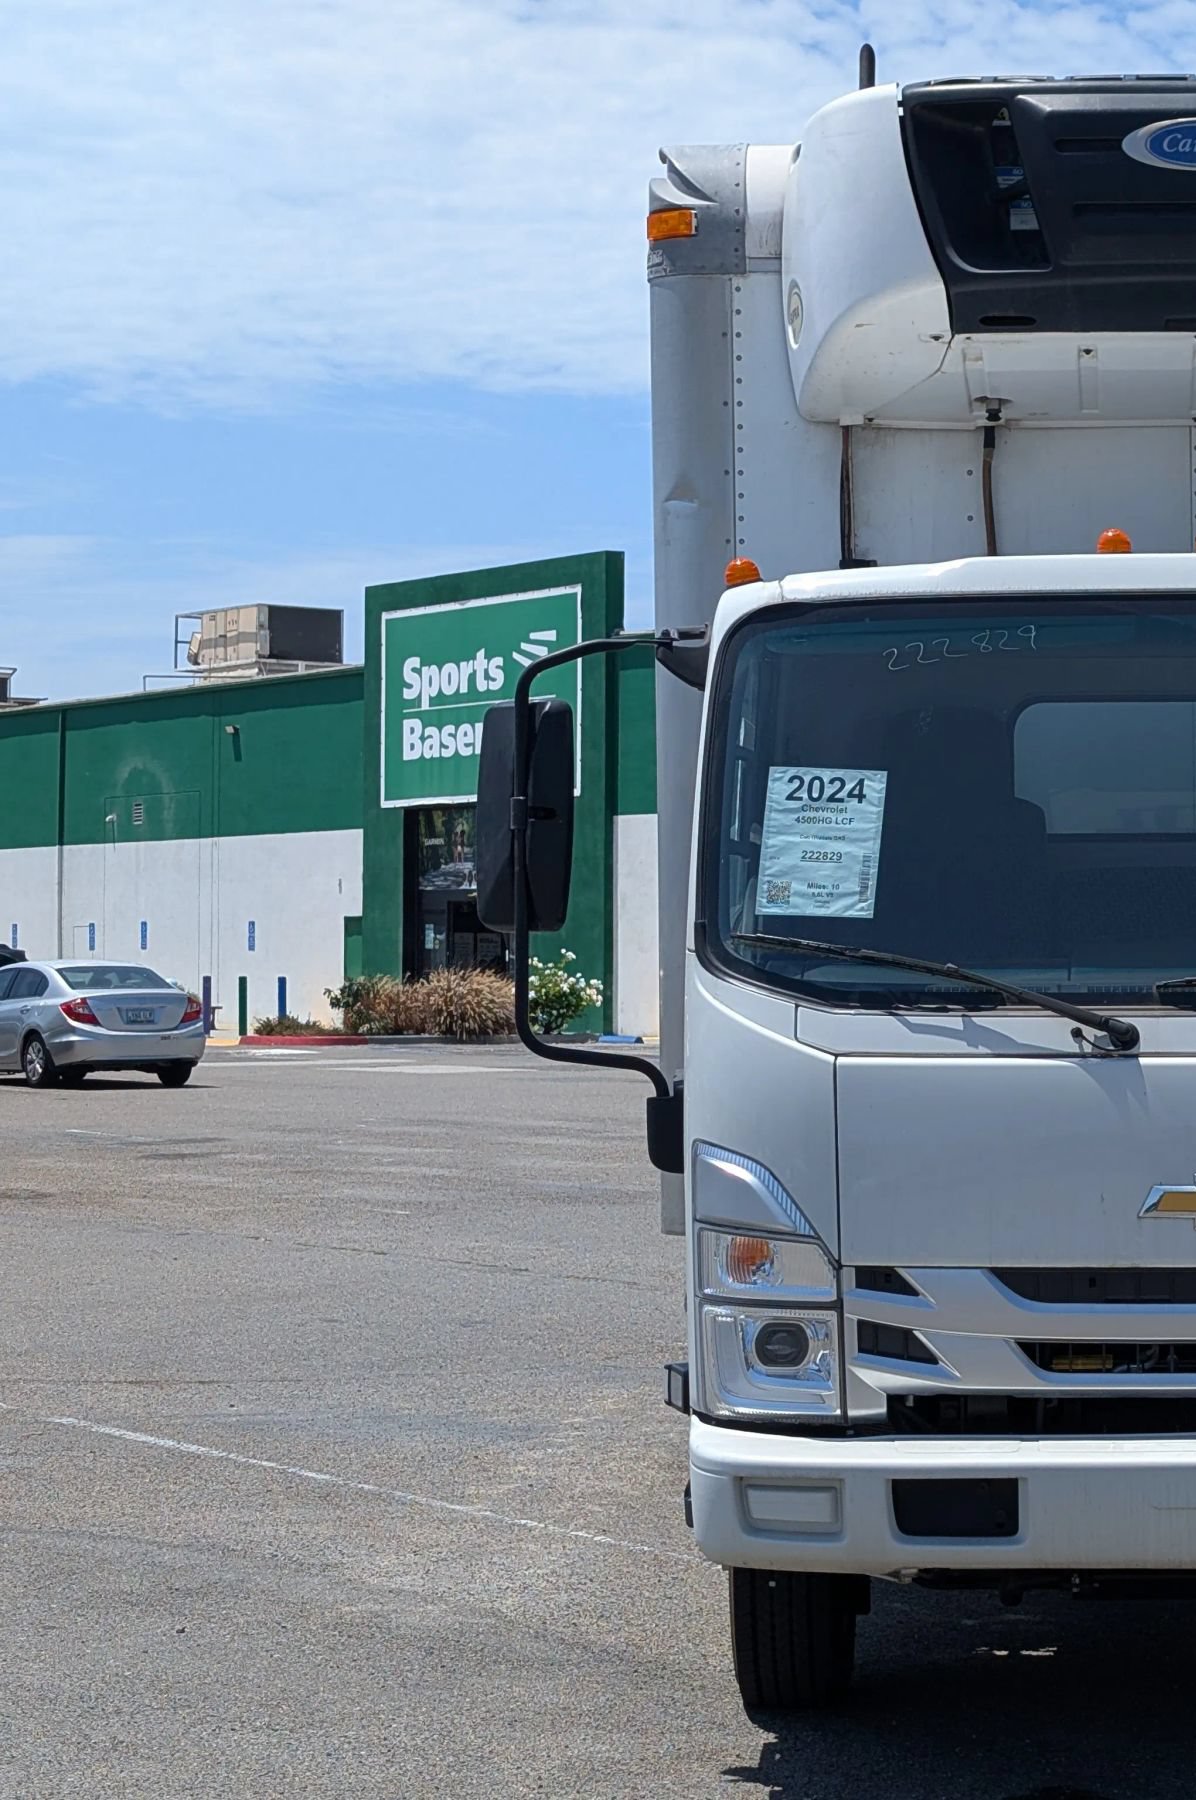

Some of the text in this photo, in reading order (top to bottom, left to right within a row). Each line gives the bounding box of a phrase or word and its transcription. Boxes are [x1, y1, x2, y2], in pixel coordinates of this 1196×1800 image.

[402, 647, 505, 709] Sports
[784, 774, 867, 804] 2024
[800, 803, 848, 814] Chevrolet
[794, 815, 856, 826] 4500HG LCF
[800, 850, 843, 861] 222829
